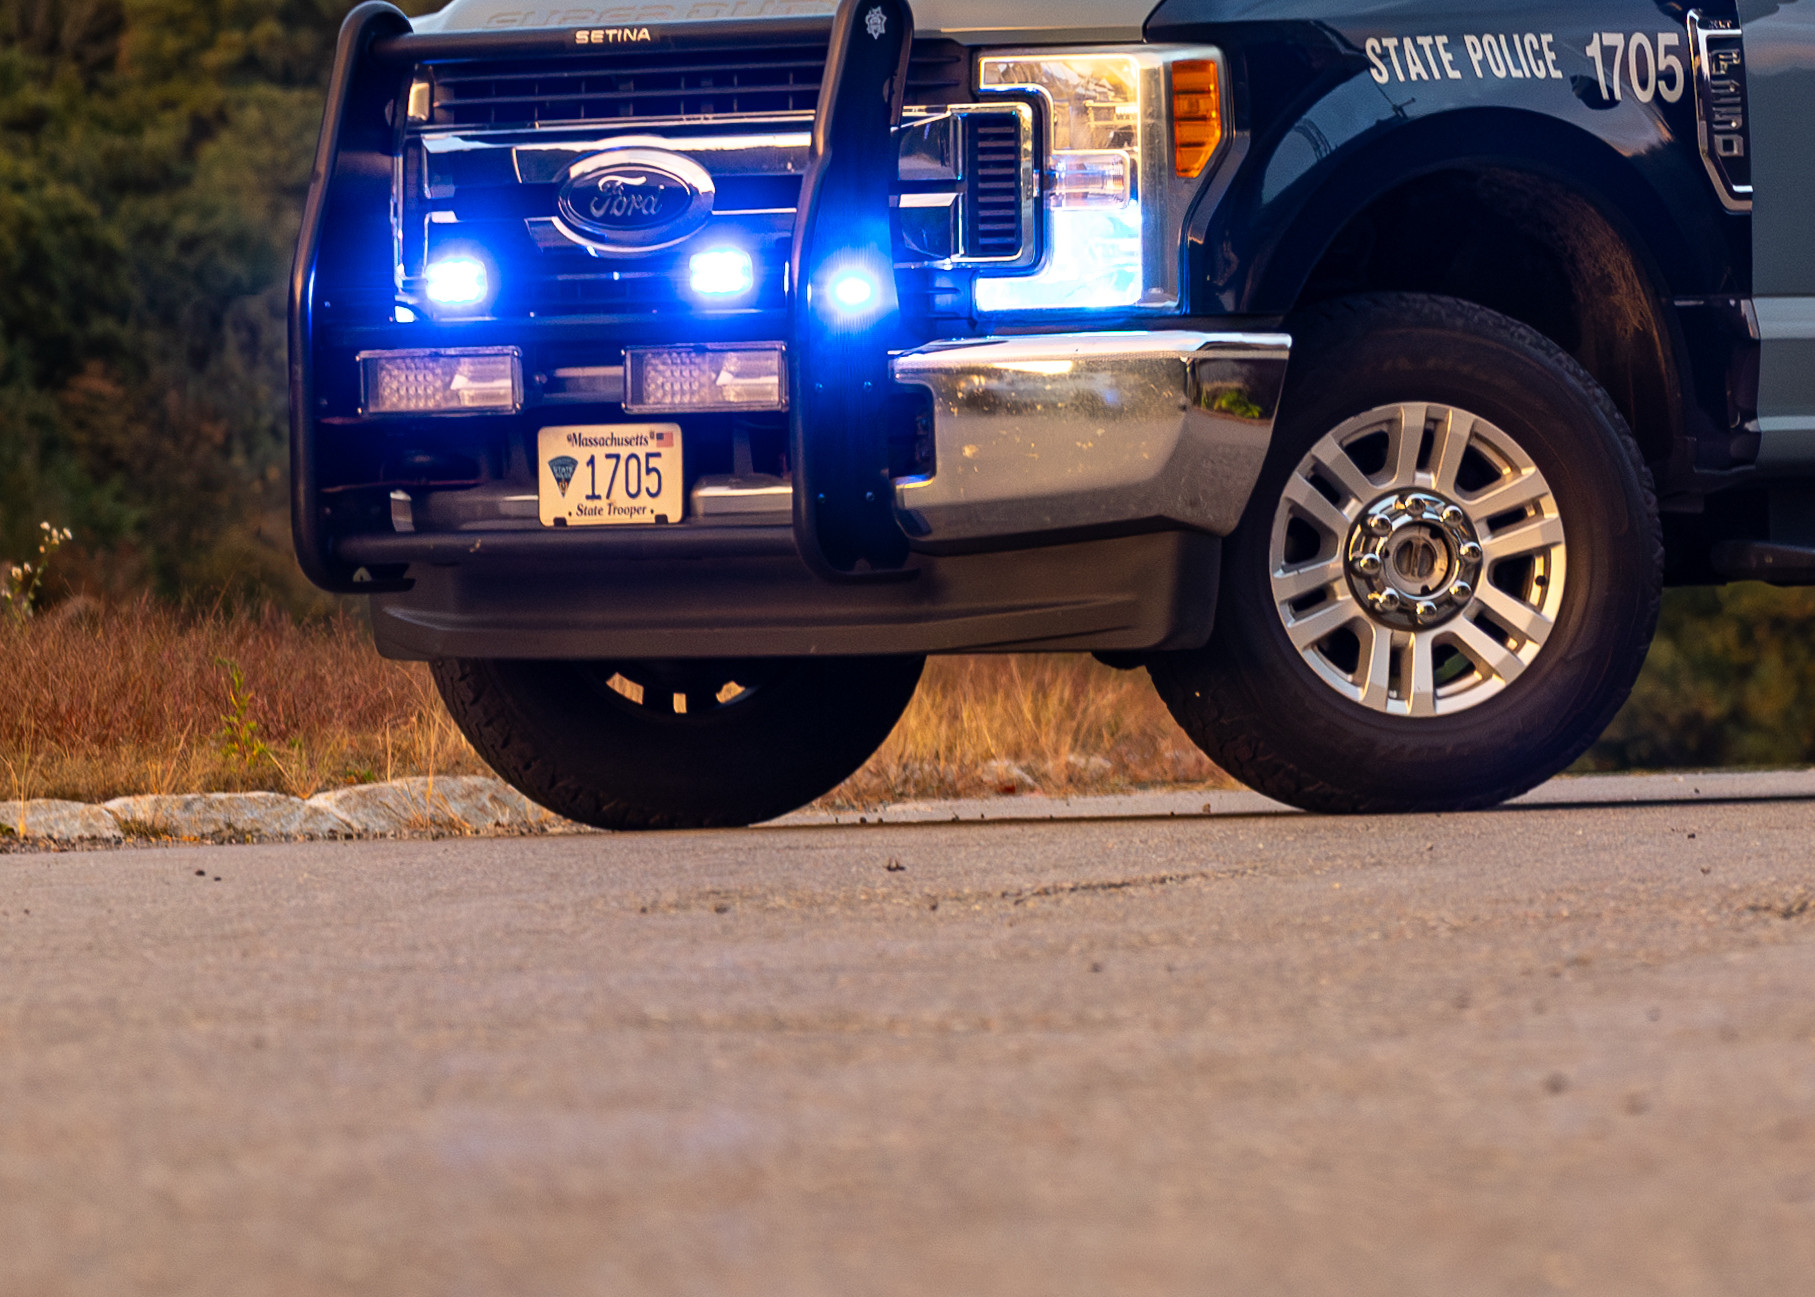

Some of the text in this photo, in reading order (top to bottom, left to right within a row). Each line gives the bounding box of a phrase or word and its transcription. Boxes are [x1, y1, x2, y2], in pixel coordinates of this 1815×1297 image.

[484, 4, 676, 29] SUPER
[575, 27, 651, 44] SETINA
[1365, 32, 1685, 104] STATE POLICE 1705
[590, 175, 664, 218] Ford
[571, 432, 649, 447] Massachusetts
[585, 451, 662, 500] 1705
[576, 503, 647, 519] State Trooper
